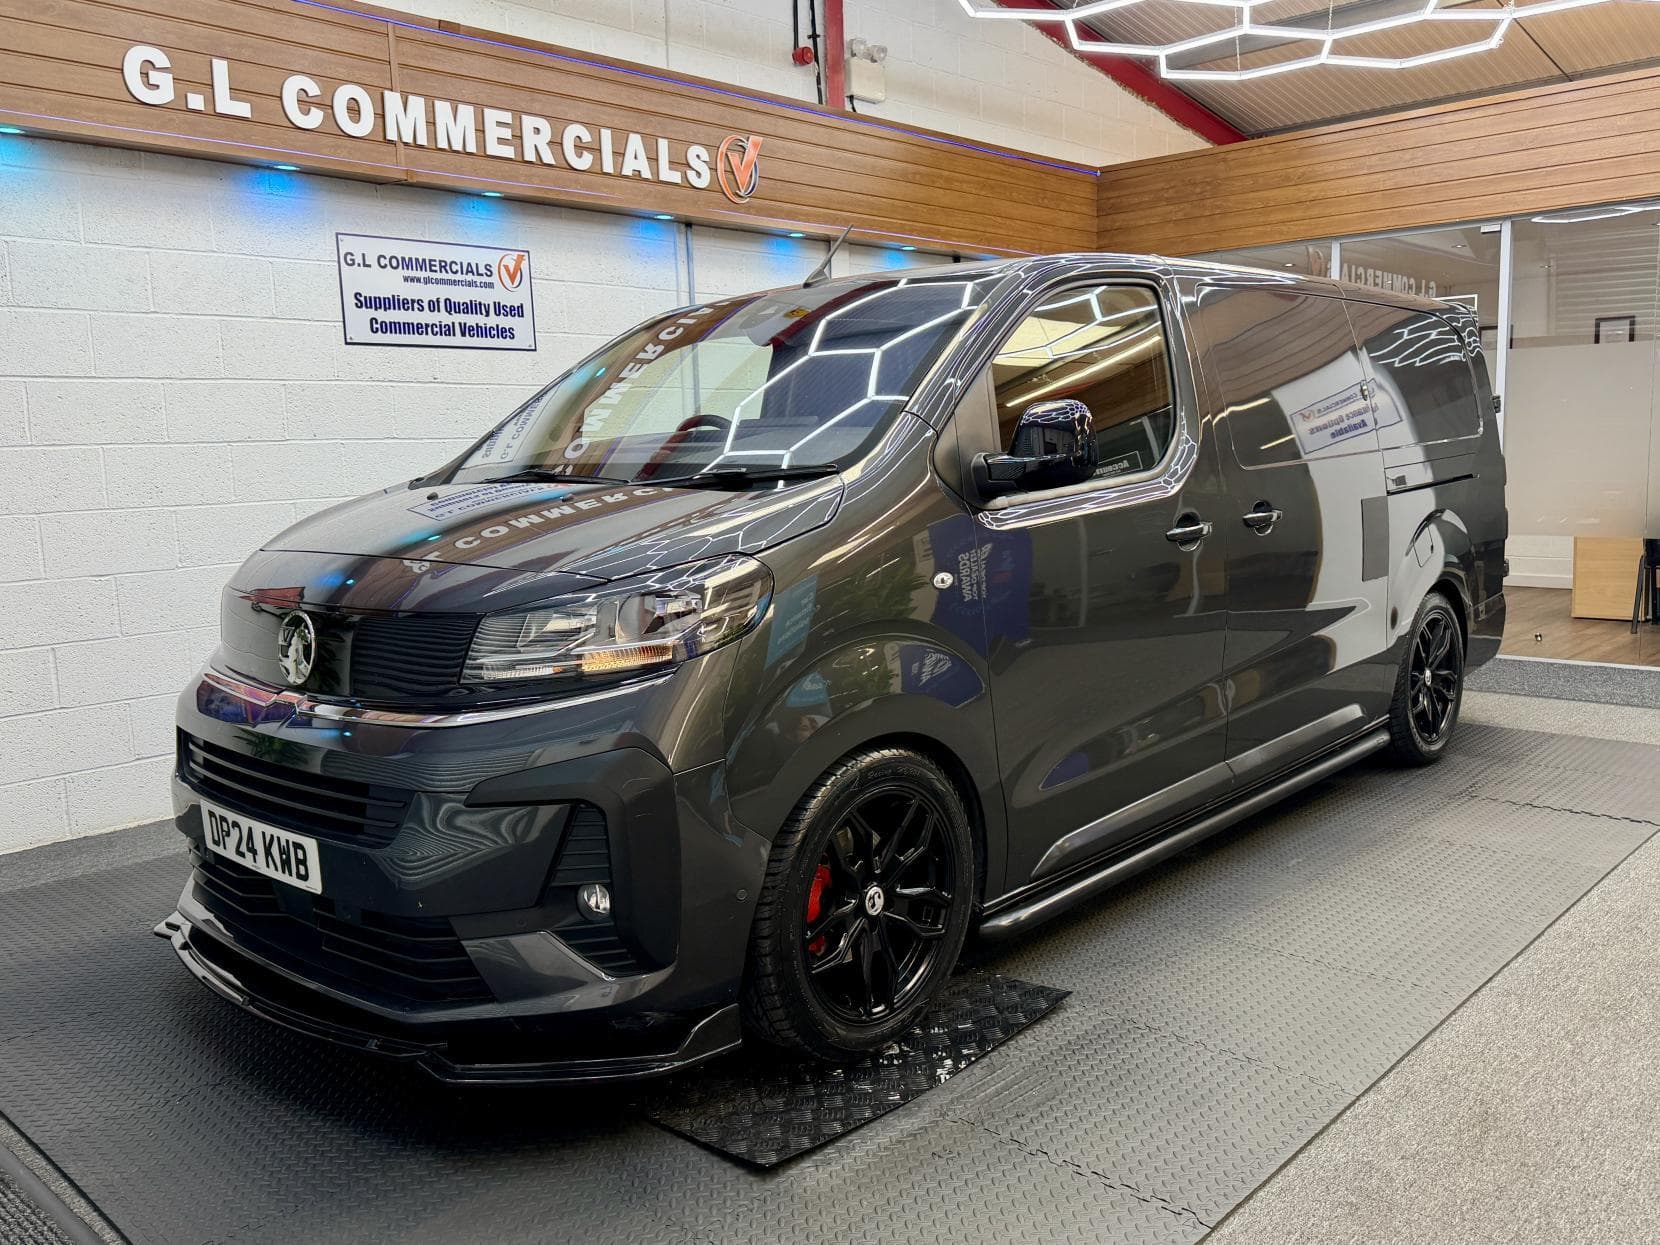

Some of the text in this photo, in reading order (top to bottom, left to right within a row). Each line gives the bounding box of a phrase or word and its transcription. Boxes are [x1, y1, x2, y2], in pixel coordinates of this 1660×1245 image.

[122, 45, 711, 190] G.L COMMERCIALS
[343, 251, 493, 278] G.L COMMERCIALS
[403, 274, 495, 289] www.glcommercials.com
[354, 292, 525, 318] Suppliers of Quality Used
[369, 317, 515, 340] Commercial Vehicles
[207, 809, 310, 882] DP24 KWB
